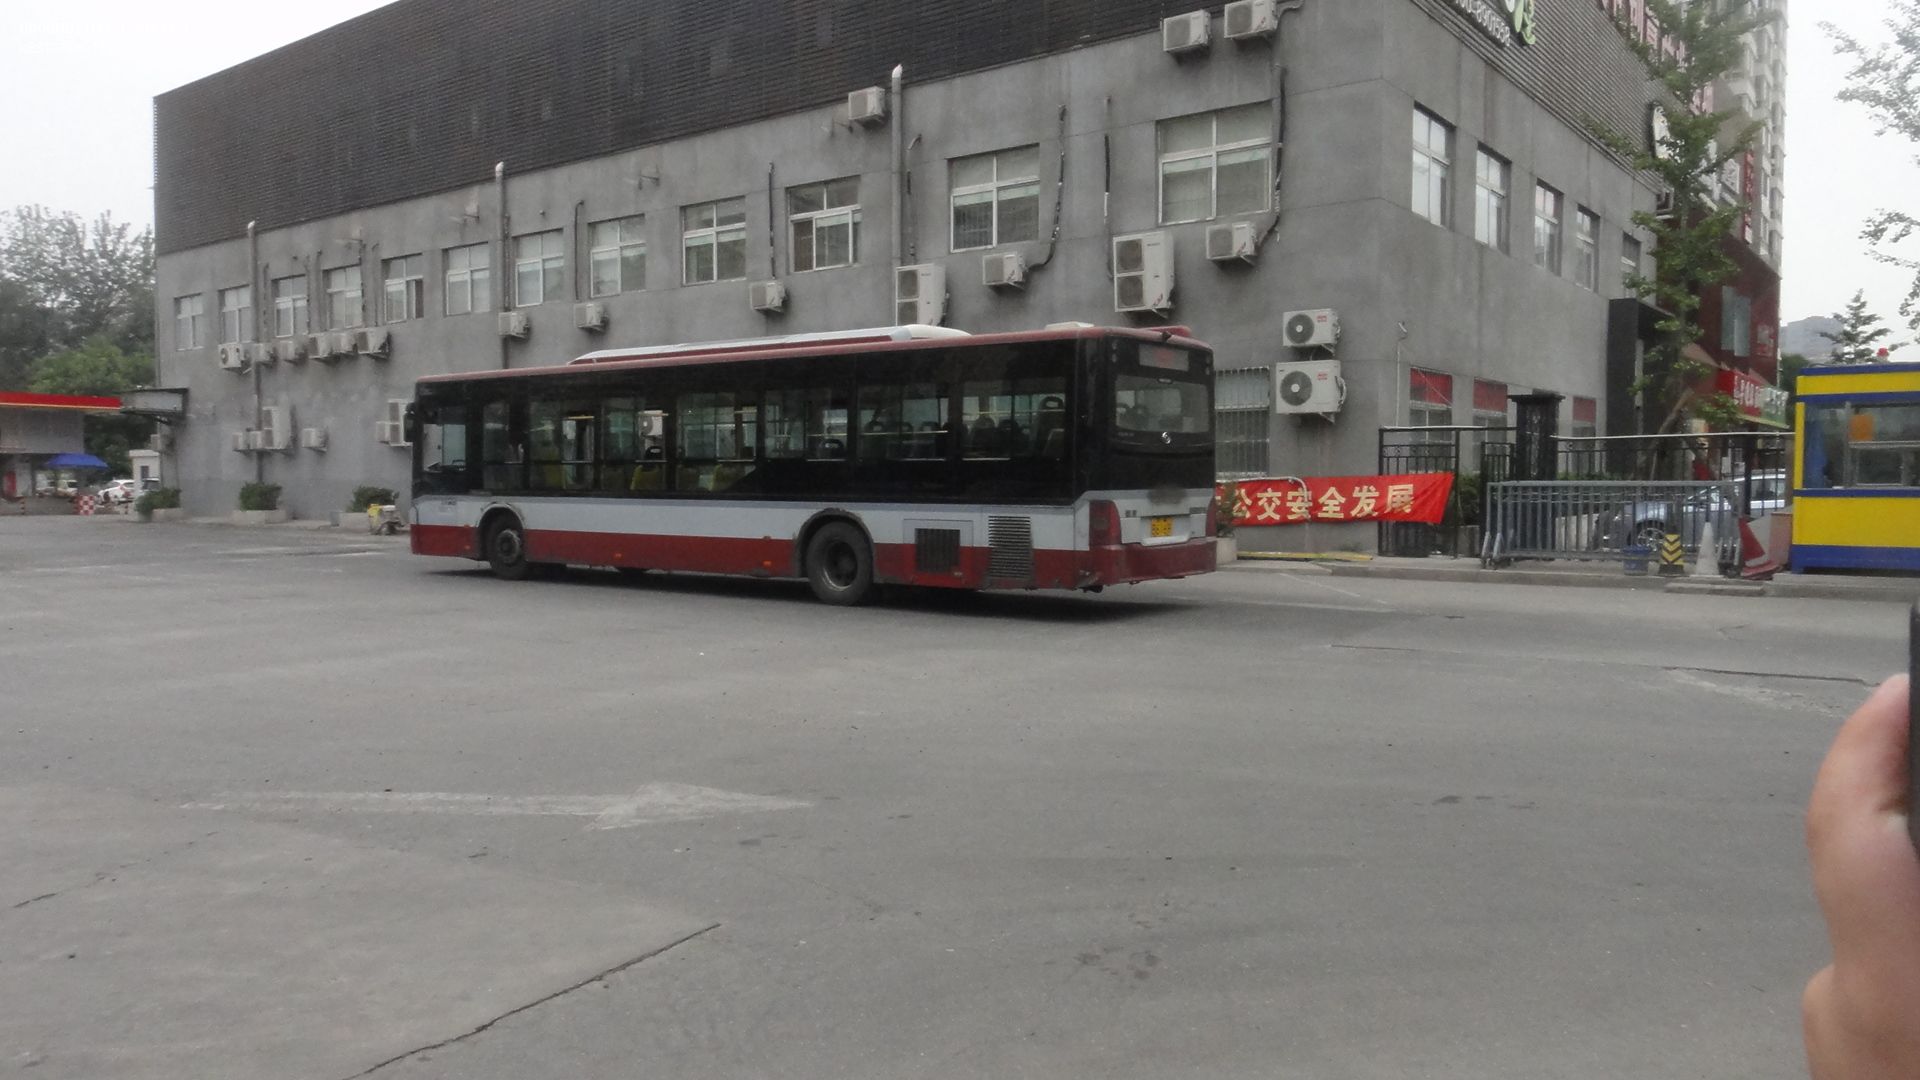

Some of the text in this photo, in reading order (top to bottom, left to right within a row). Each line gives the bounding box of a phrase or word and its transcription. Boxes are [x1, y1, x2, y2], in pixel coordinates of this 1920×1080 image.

[1231, 483, 1415, 521] 公交安全发展
